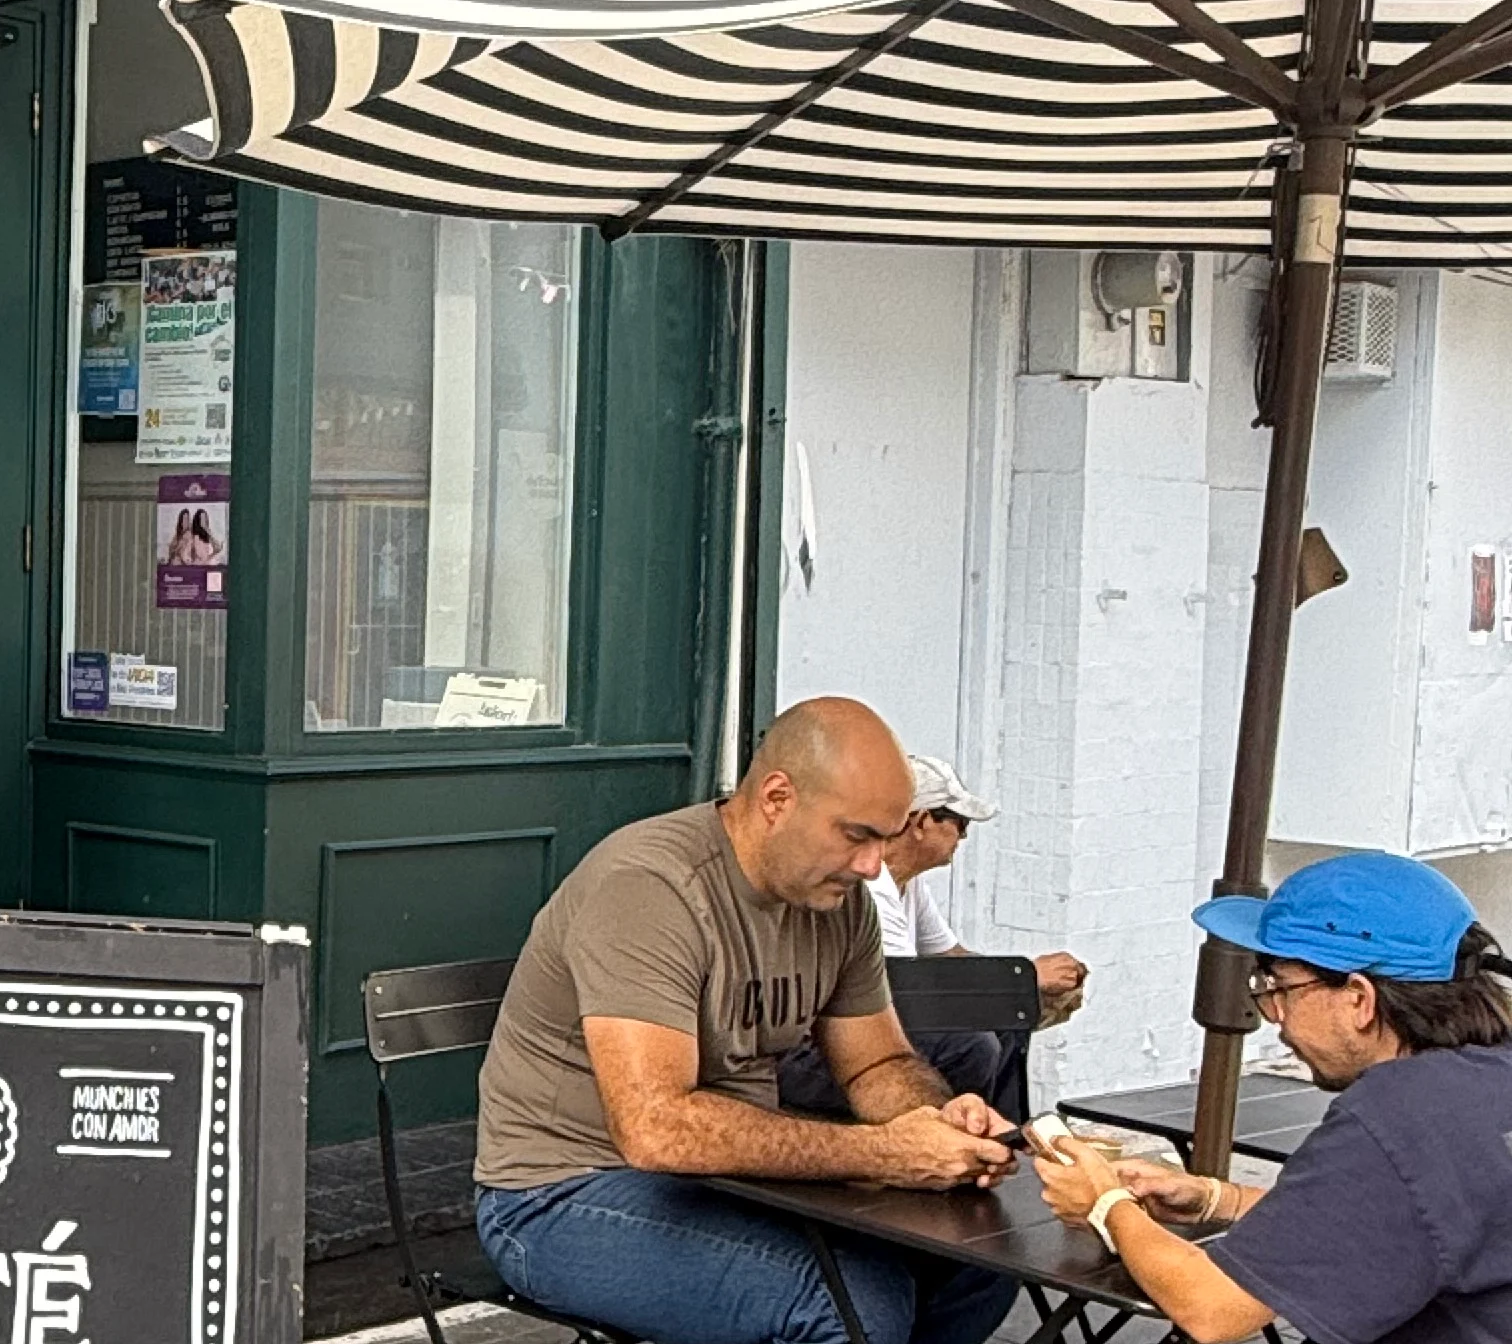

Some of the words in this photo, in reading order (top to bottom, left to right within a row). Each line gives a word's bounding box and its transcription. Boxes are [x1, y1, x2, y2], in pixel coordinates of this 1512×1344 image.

[72, 1084, 160, 1114] MUNCHIES
[71, 1112, 108, 1140] CON
[108, 1113, 160, 1144] AMOR
